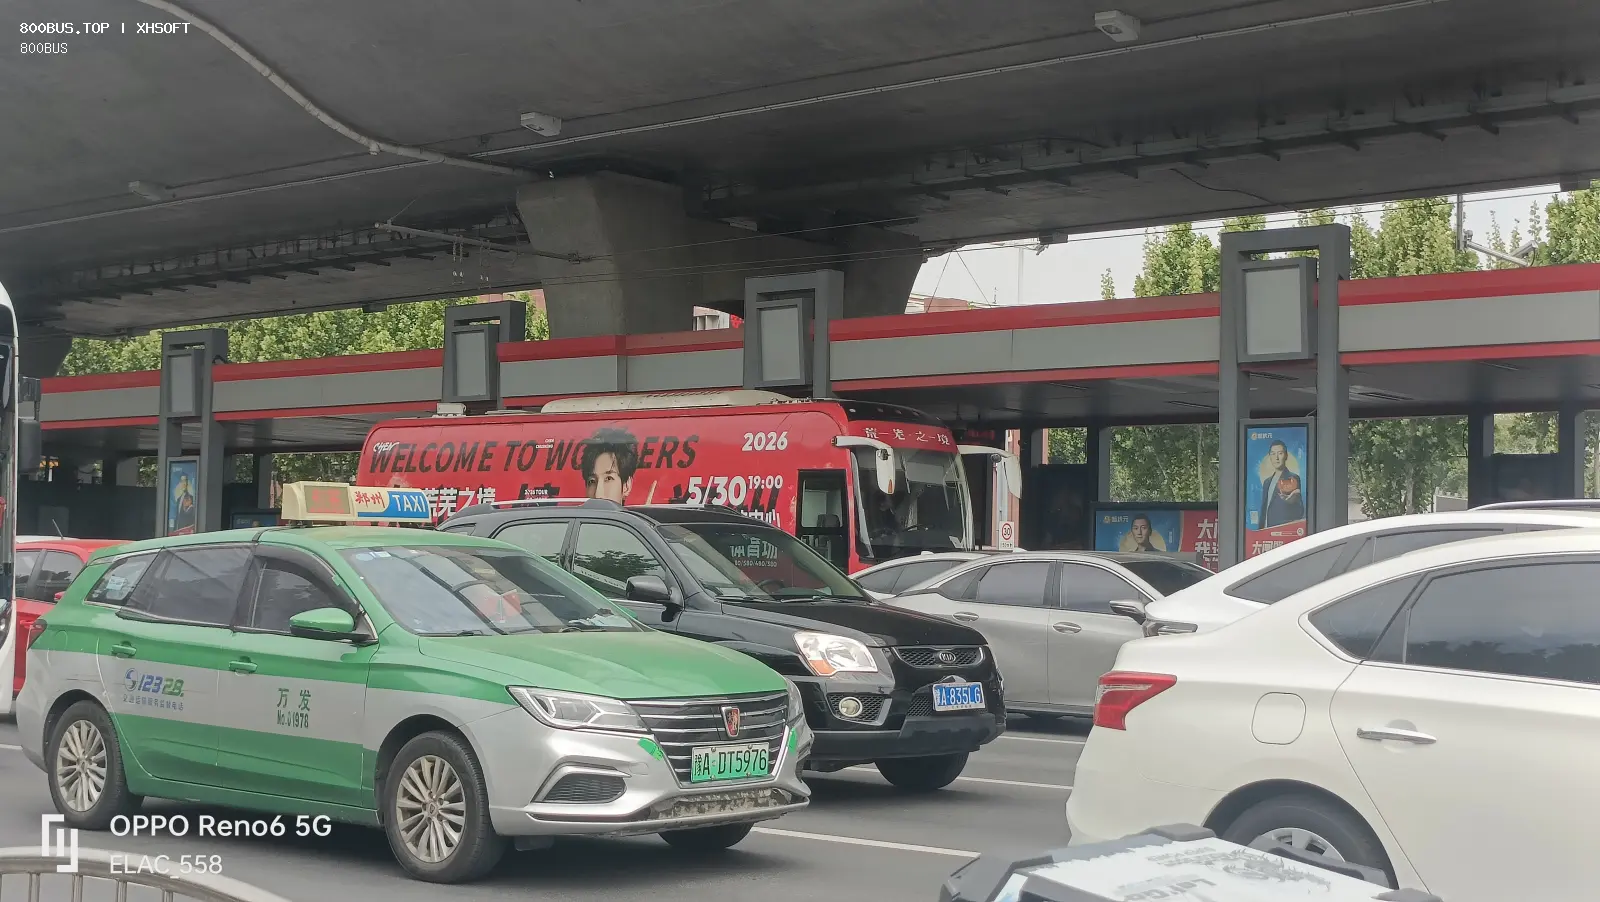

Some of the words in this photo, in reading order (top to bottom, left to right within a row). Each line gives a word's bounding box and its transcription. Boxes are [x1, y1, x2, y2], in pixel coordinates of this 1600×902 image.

[741, 431, 789, 452] 2026
[370, 440, 499, 474] WELCOME
[503, 440, 538, 472] TO
[355, 490, 386, 508] 郑州
[686, 475, 747, 506] 5/30
[748, 474, 784, 490] 19:00
[391, 494, 427, 513] TAXI
